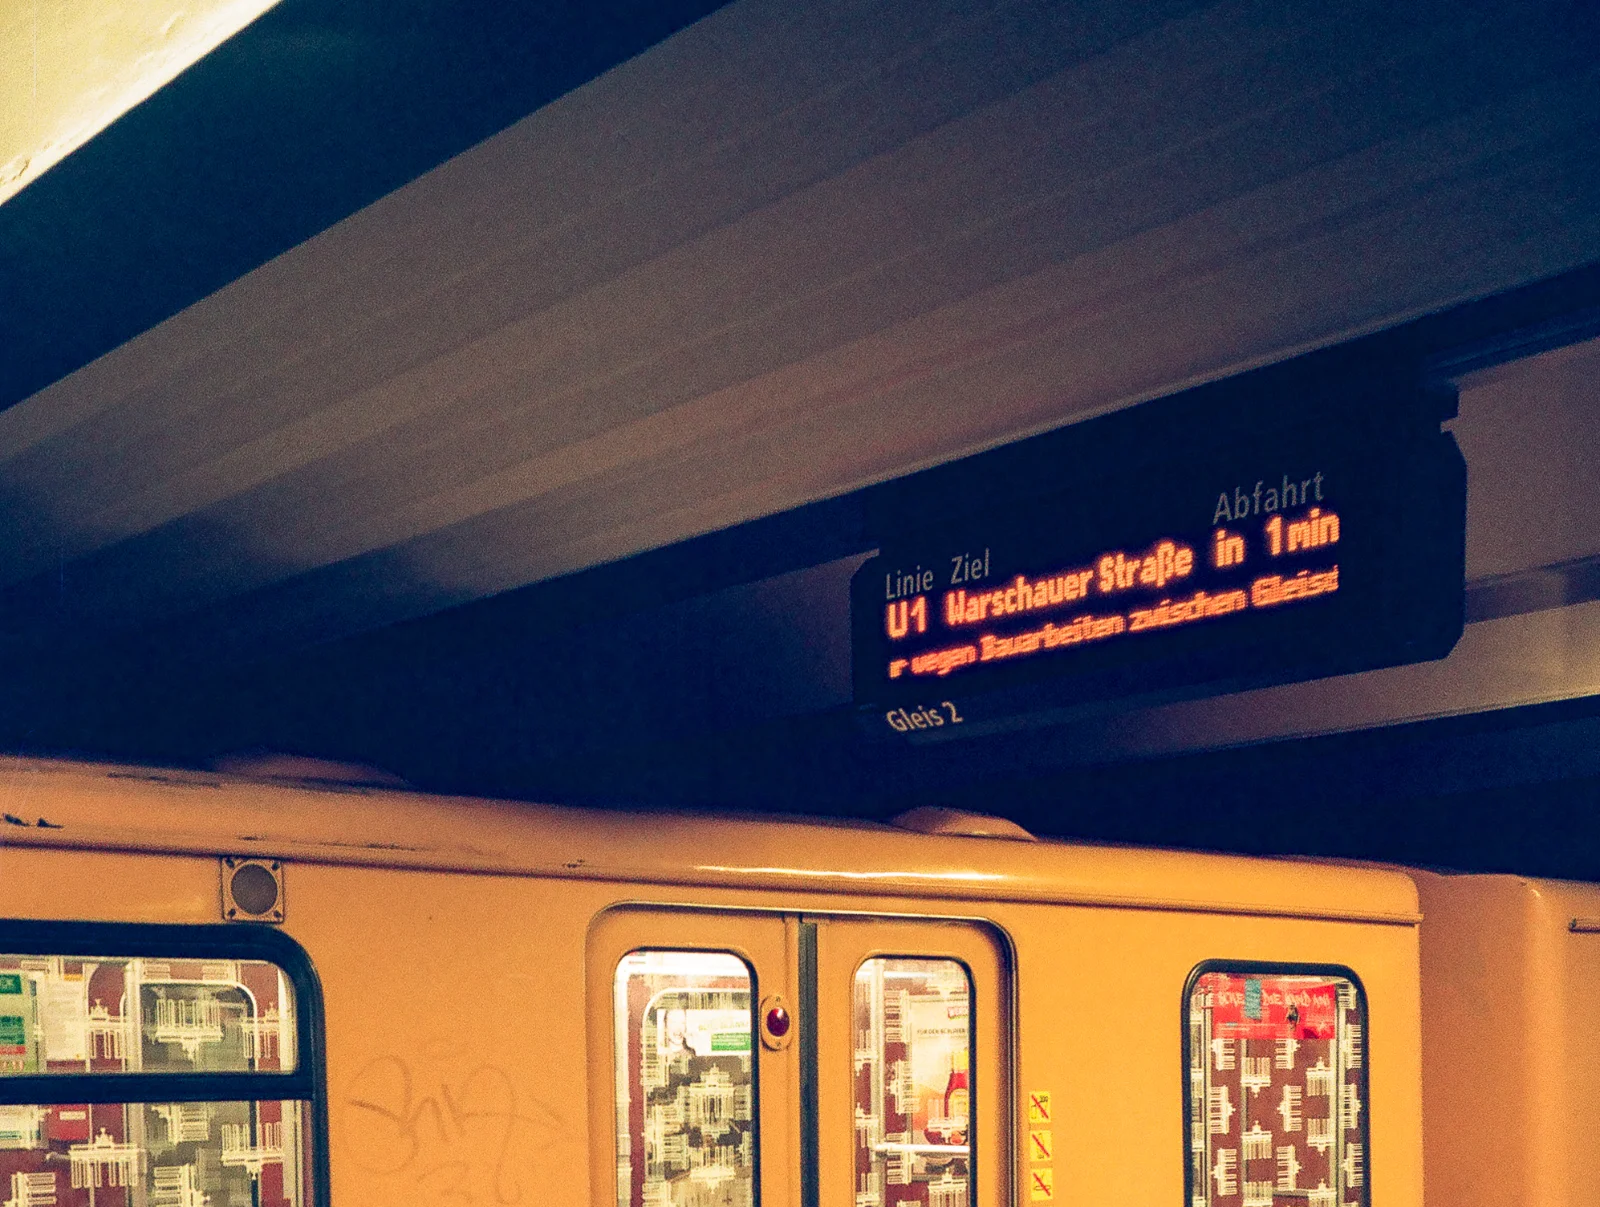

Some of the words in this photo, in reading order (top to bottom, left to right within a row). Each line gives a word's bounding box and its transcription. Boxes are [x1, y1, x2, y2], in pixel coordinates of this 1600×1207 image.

[1213, 471, 1324, 525] Abfahrt
[886, 565, 934, 599] Linie
[951, 548, 990, 585] Ziel
[887, 596, 926, 638] U1
[946, 575, 1094, 626] Warschauer
[1099, 541, 1193, 593] Straße
[1216, 529, 1244, 568] in
[911, 645, 976, 675] wegen
[979, 614, 1126, 661] Bauarbeiten
[1128, 590, 1246, 631] zwischen
[886, 704, 944, 732] Gleis
[941, 701, 963, 723] 2
